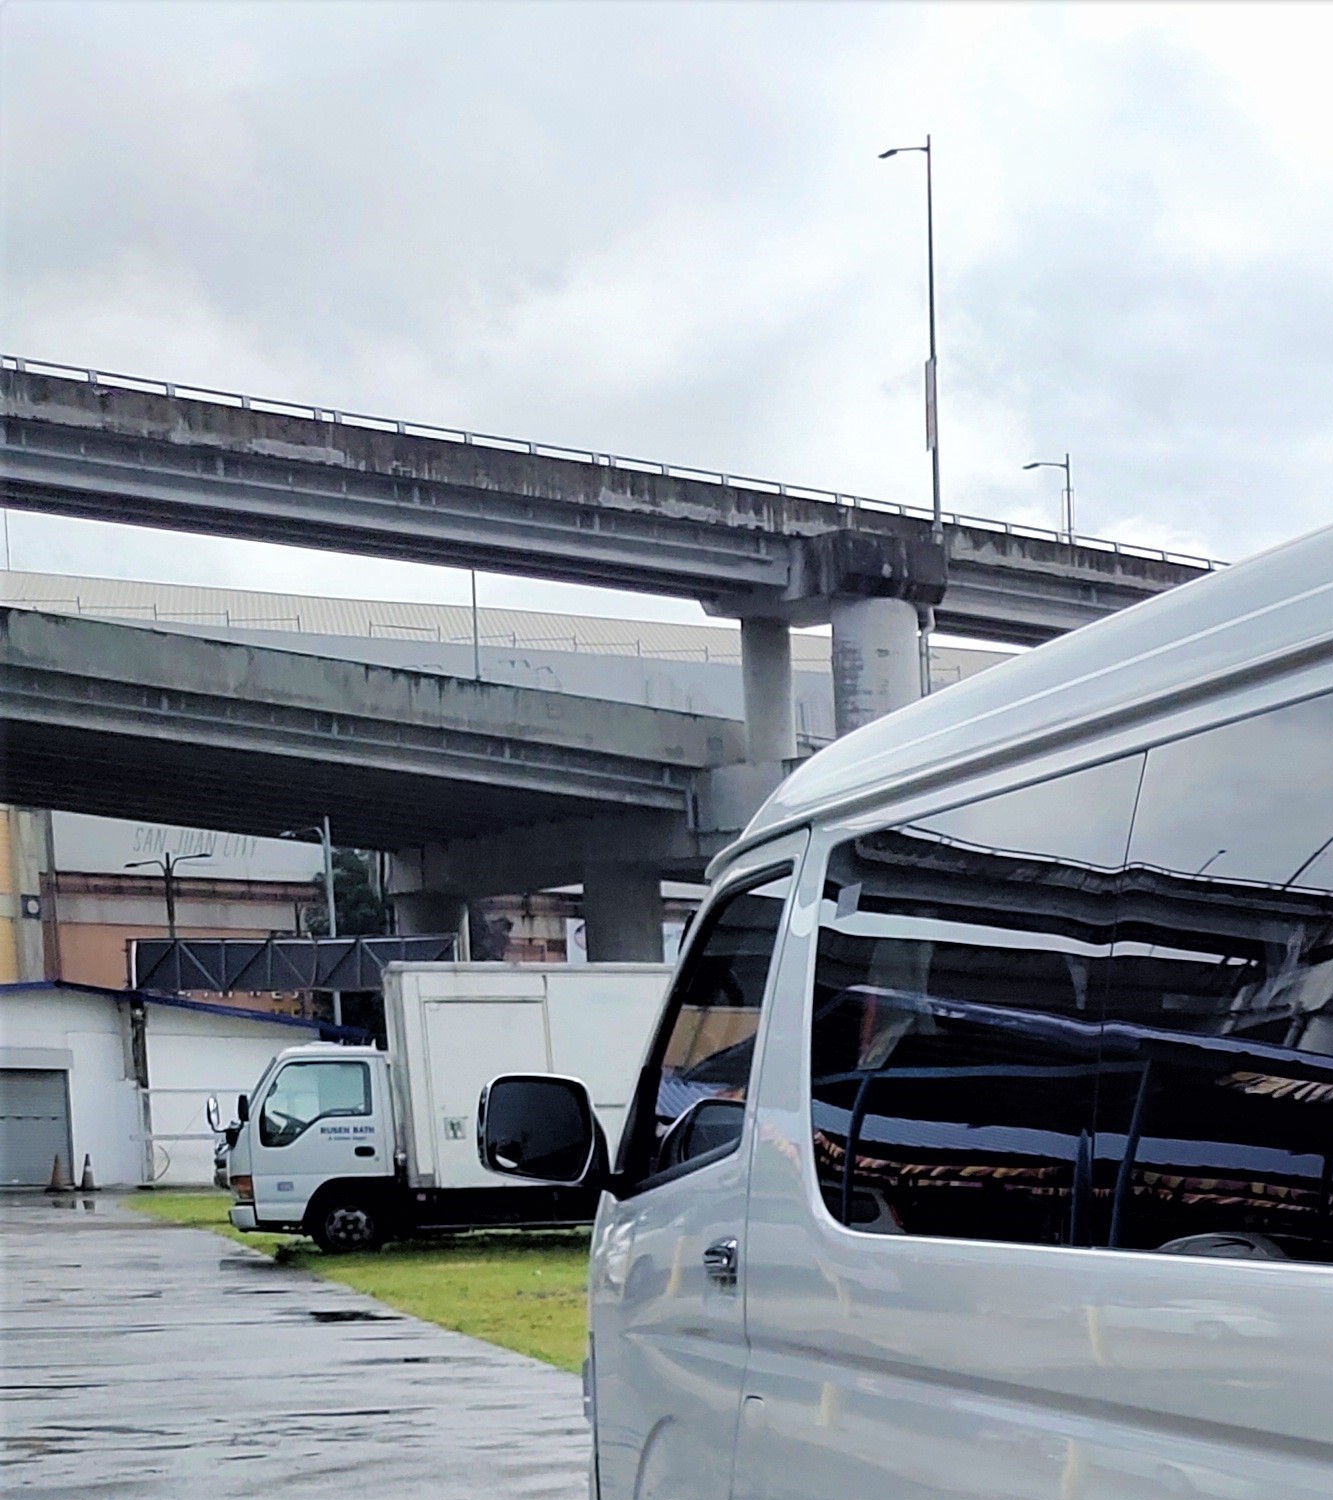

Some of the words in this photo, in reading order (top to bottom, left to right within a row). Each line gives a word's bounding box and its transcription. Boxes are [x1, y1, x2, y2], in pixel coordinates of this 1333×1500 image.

[133, 827, 167, 853] SAN
[172, 829, 217, 855] JUAN
[353, 1125, 375, 1135] BATH
